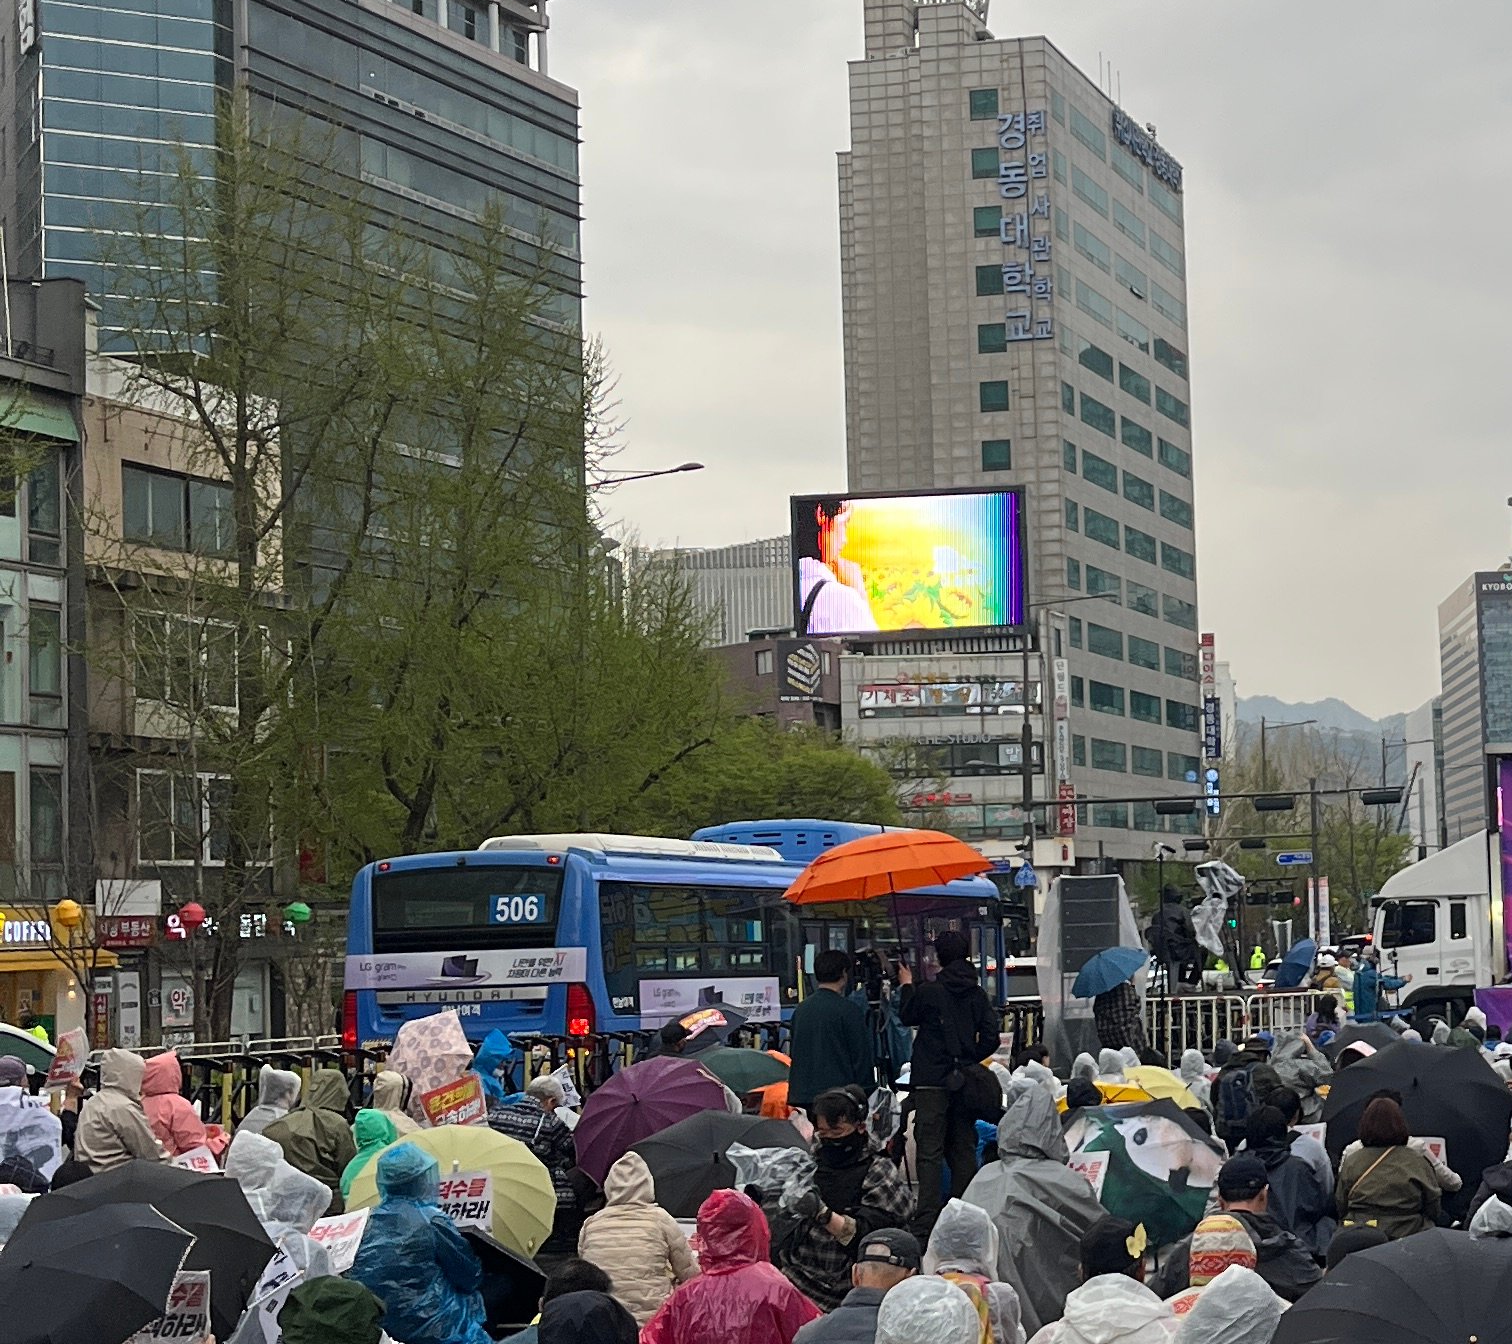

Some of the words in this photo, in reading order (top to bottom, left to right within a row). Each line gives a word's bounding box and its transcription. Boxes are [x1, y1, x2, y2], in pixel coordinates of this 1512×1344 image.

[997, 113, 1034, 342] 경동대학교
[1027, 110, 1054, 340] 취업사관학교
[1482, 582, 1512, 591] KYOBO
[1203, 652, 1214, 684] 다이소
[948, 734, 991, 744] STUDIO
[495, 896, 539, 922] 506
[121, 920, 150, 937] 부동산
[360, 962, 372, 971] LG
[374, 962, 397, 973] gram
[171, 988, 188, 1015] 약
[406, 989, 514, 1002] HYUNDAI
